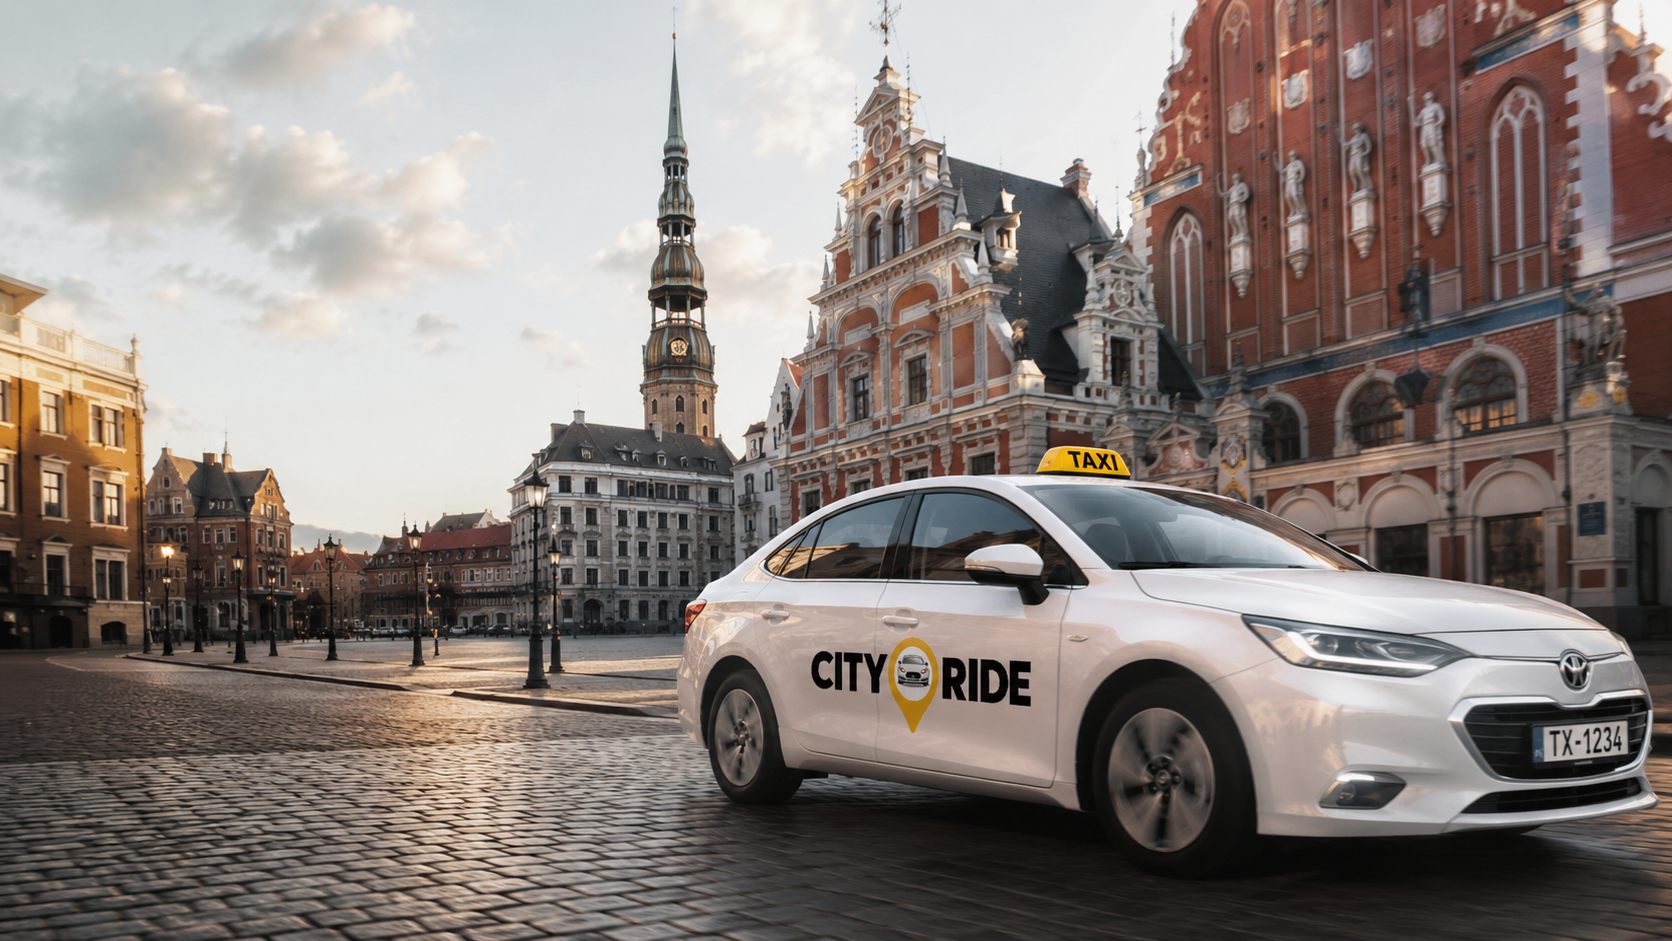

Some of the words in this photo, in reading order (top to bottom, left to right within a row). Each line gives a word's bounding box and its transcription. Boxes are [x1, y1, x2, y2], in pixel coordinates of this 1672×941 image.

[1067, 450, 1119, 471] TAXI
[811, 651, 888, 694] CITY
[942, 657, 1031, 707] RIDE
[1549, 725, 1622, 757] TX-1234
